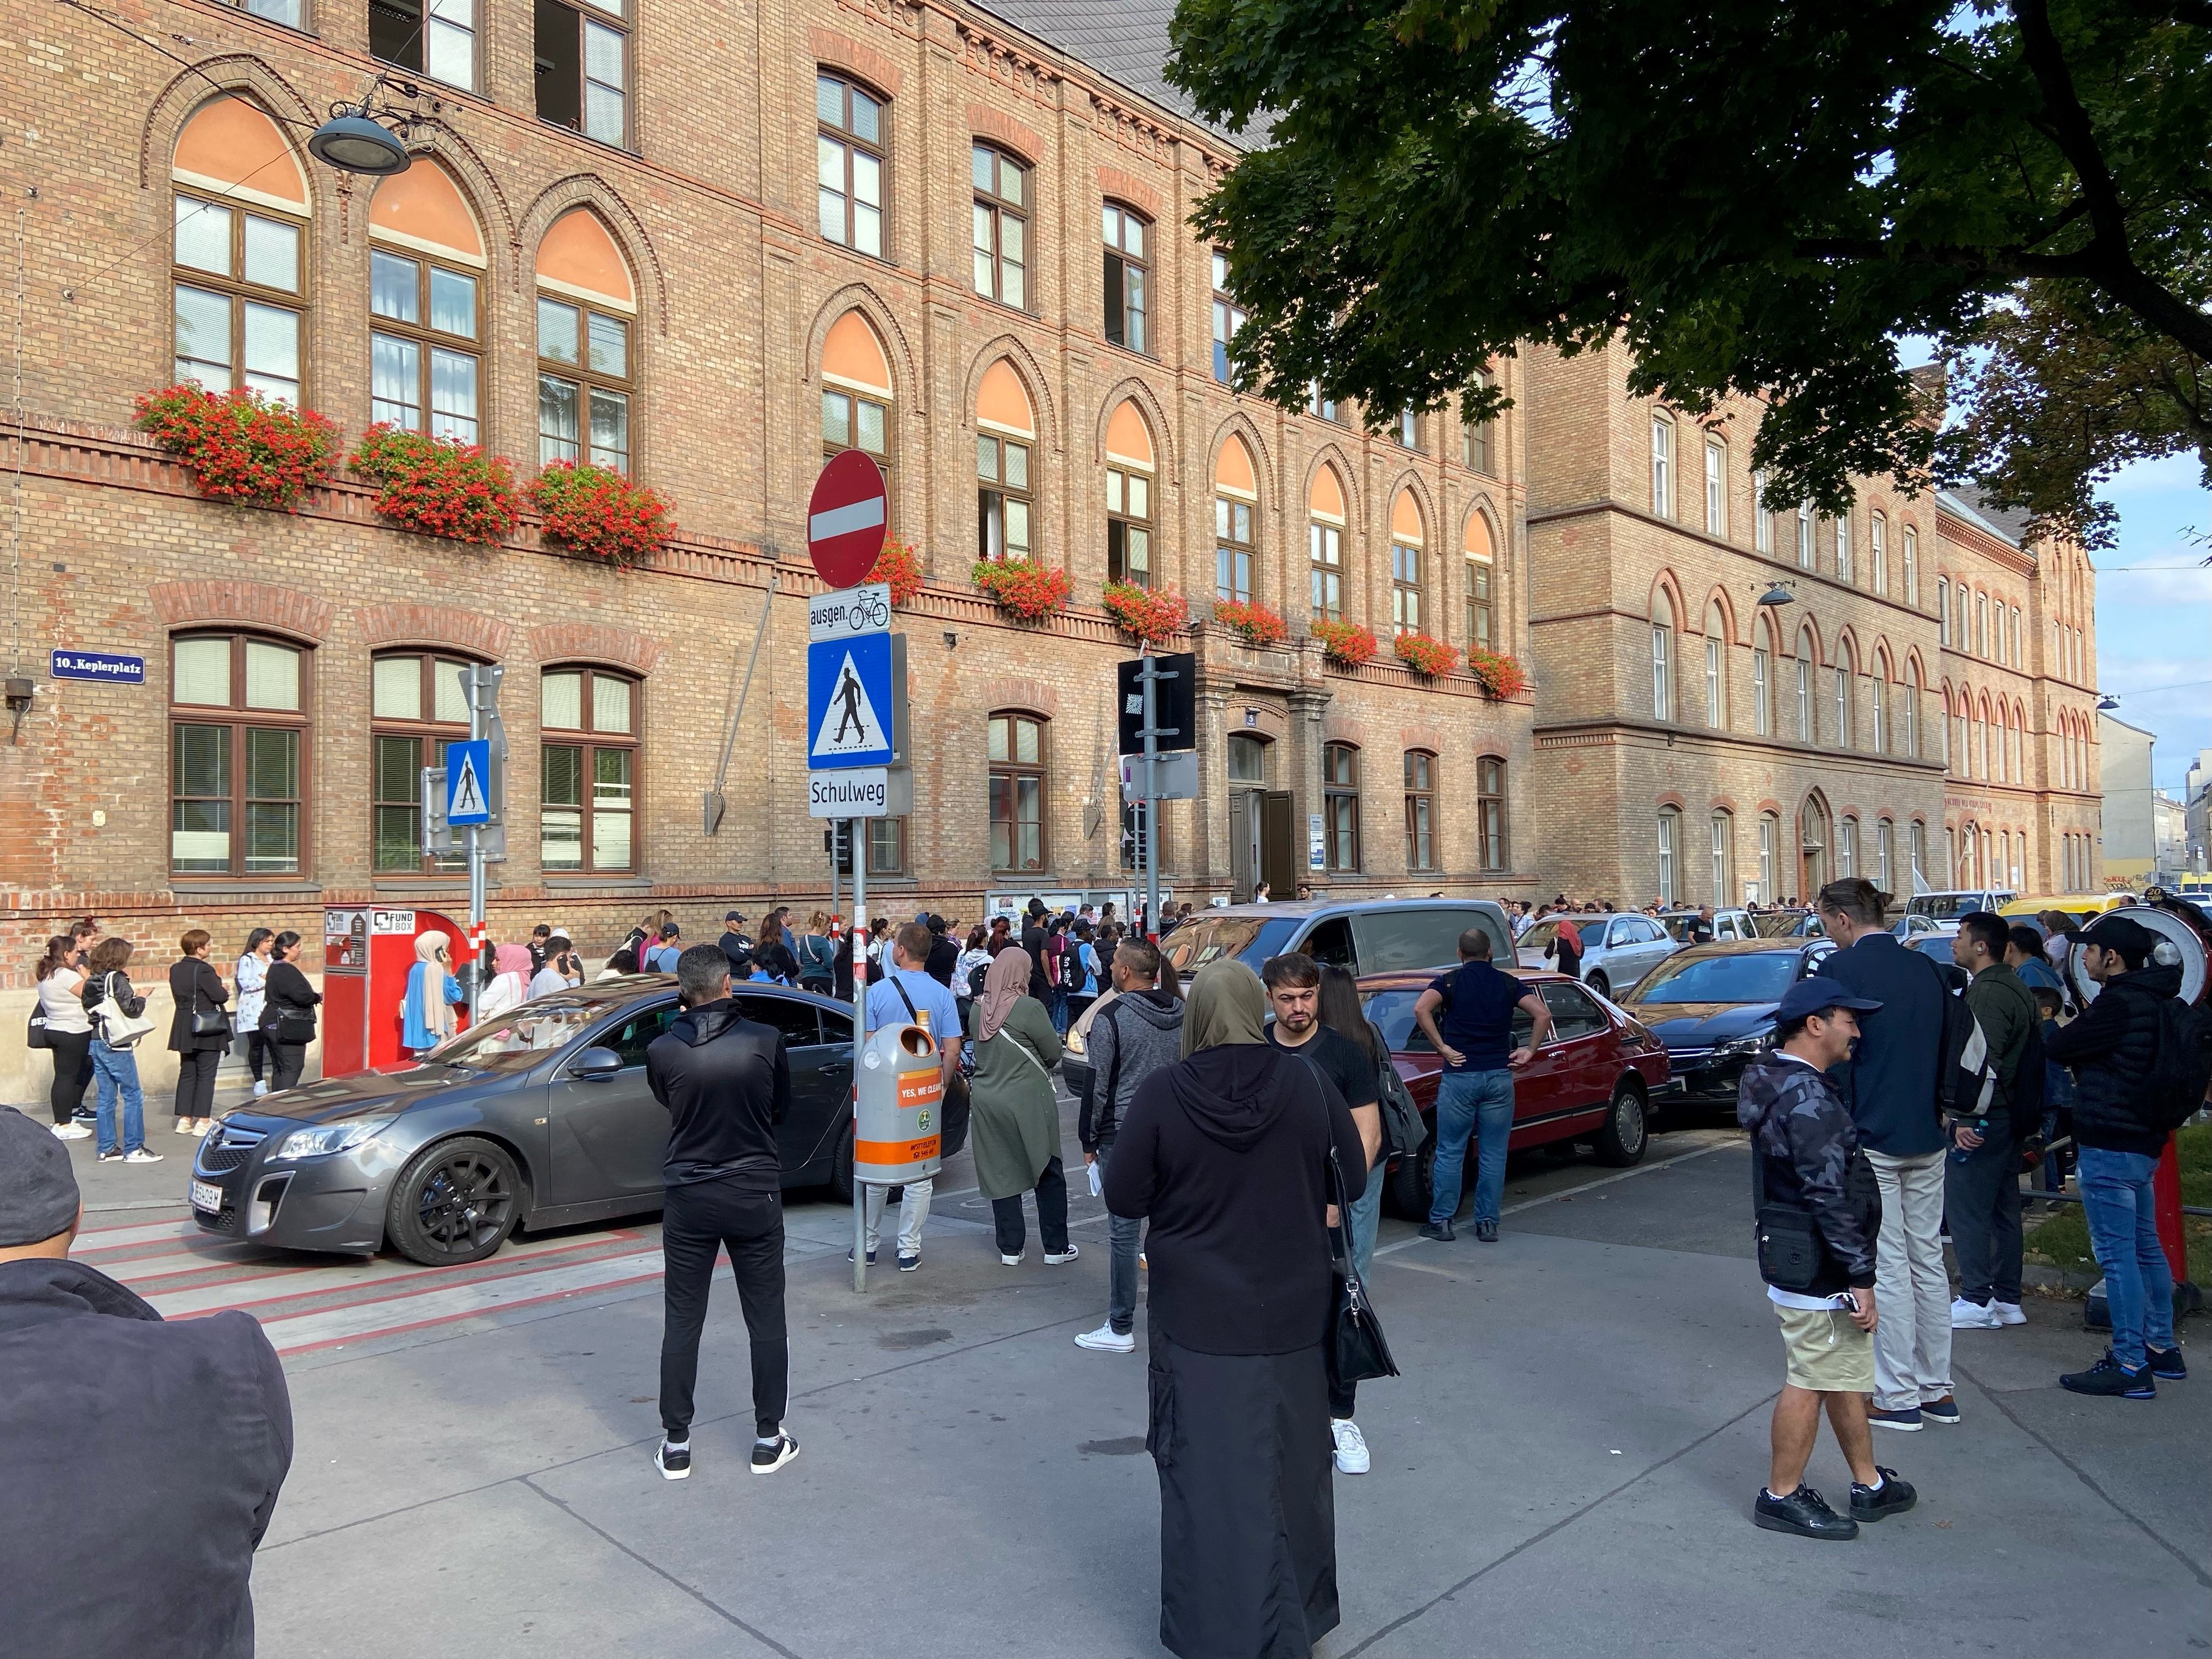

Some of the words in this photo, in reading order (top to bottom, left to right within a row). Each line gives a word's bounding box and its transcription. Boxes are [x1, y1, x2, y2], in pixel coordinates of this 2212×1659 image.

[811, 605, 848, 628] ausgen.
[1249, 714, 1253, 723] 5
[812, 780, 884, 806] Schulweg
[390, 913, 413, 922] FUND
[395, 922, 413, 931] BOX
[901, 1088, 916, 1098] YES,
[917, 1086, 927, 1096] WE
